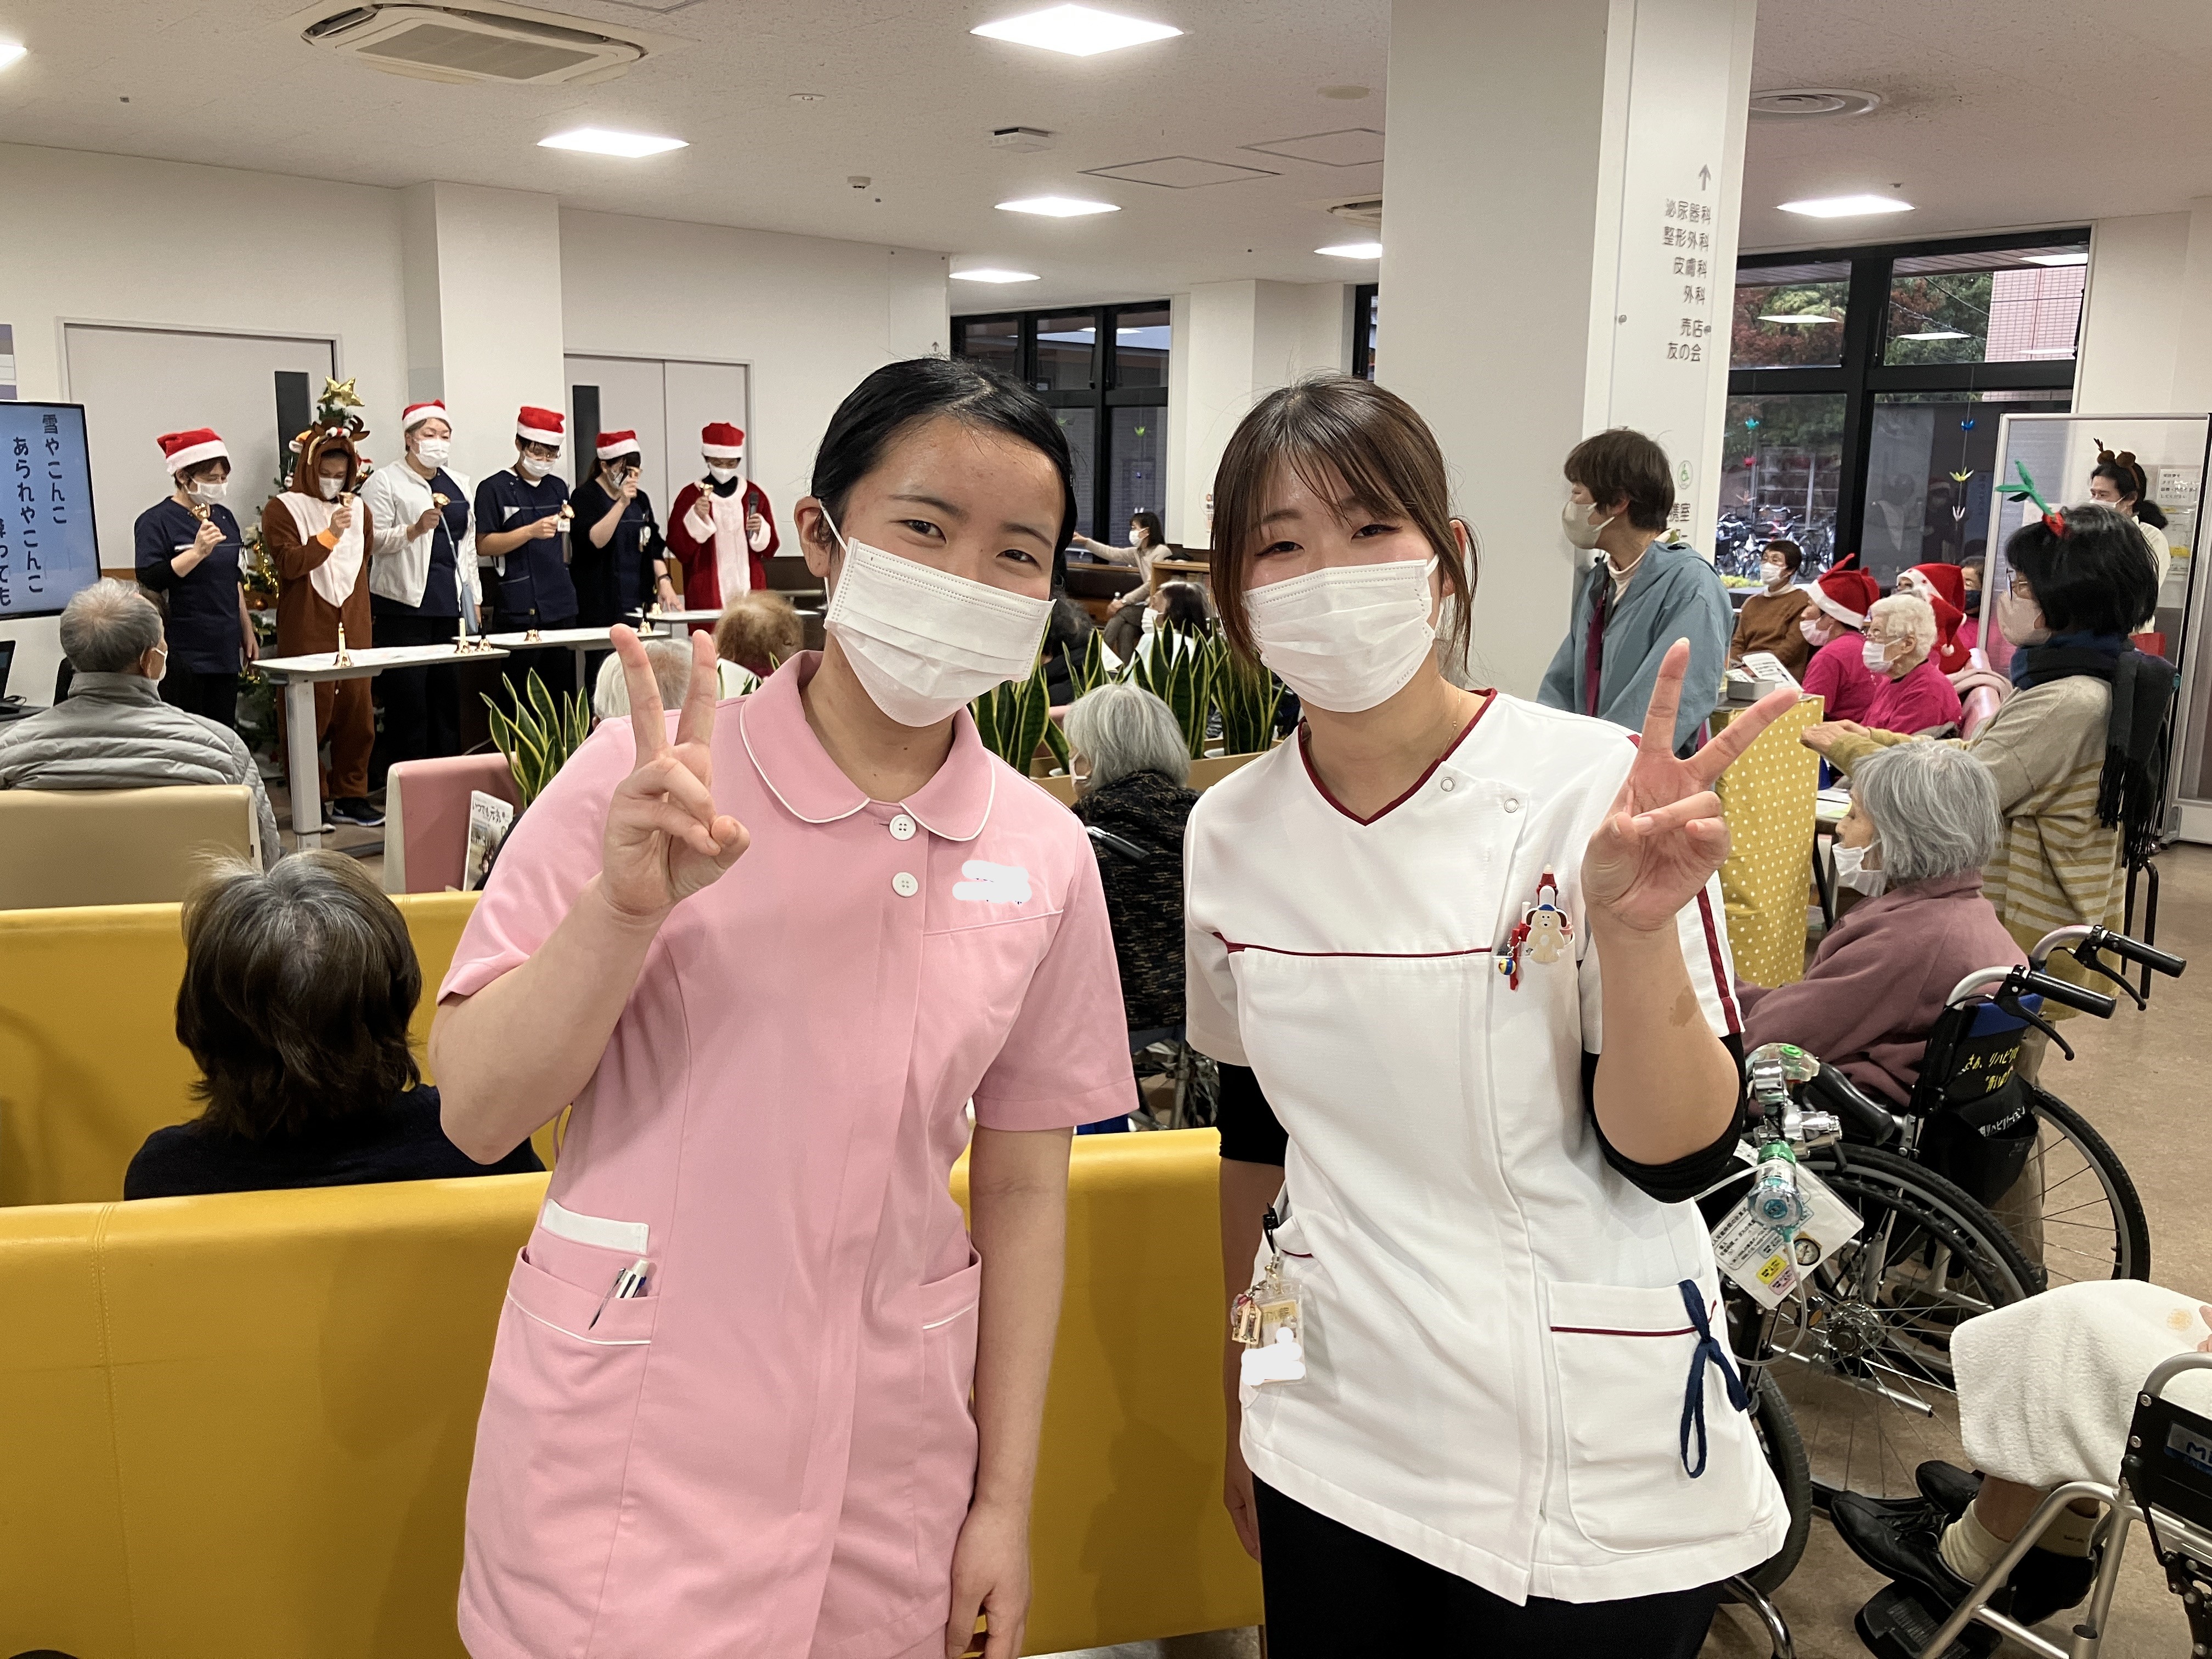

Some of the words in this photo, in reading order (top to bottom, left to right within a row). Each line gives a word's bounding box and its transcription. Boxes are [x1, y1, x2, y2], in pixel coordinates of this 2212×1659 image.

[1664, 198, 1711, 225] 泌尿器科
[1662, 225, 1709, 252] 整形外科
[1673, 256, 1707, 279] 皮膚科
[1683, 285, 1705, 305] 外科
[1680, 318, 1703, 337] 売店
[1667, 341, 1701, 362] 友の会
[42, 414, 67, 524] 雪やこんこ
[13, 437, 43, 594] あられやこんこ
